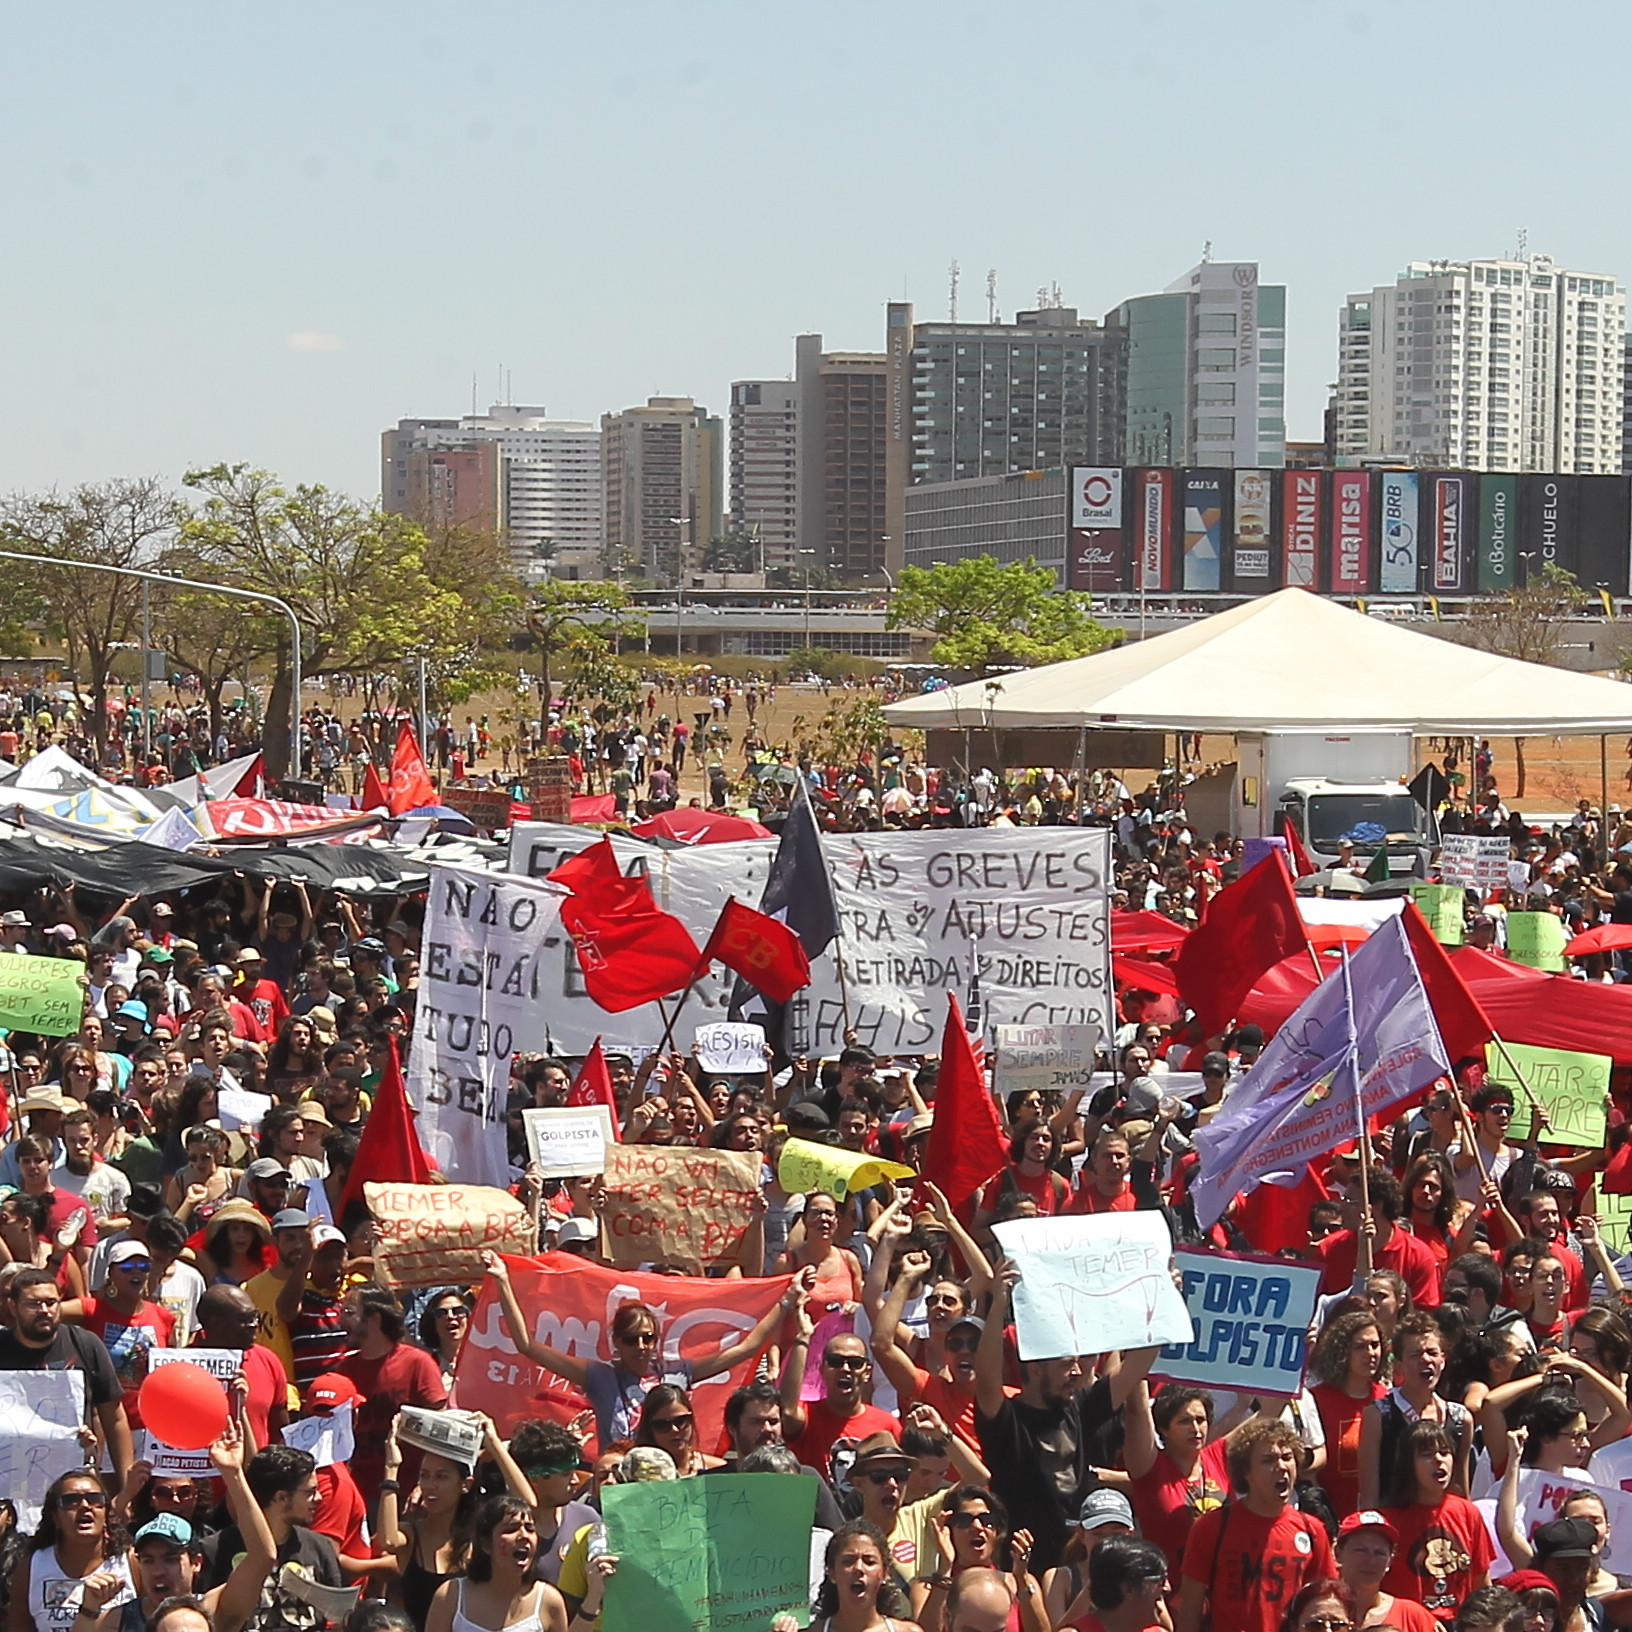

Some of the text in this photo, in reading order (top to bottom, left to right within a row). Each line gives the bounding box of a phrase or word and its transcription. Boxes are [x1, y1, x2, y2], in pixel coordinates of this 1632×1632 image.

[1187, 480, 1219, 490] CAIXA
[1386, 484, 1403, 519] BRB
[1081, 507, 1113, 518] Brasal
[1297, 476, 1316, 551] DINIZ
[1340, 482, 1362, 580] marisa
[1443, 501, 1458, 582] BAHIA
[926, 850, 1102, 894] GREVES
[444, 879, 537, 934] NÃO
[940, 897, 1107, 947] AJUSTES
[426, 940, 531, 998] ESTÁ
[29, 1014, 73, 1030] TEMER
[44, 998, 70, 1012] SEM
[1002, 1027, 1057, 1046] LUTAR
[1002, 1049, 1083, 1070] SEMPRE
[1496, 1050, 1586, 1094] LUTAR
[539, 1129, 602, 1143] GOLPISTA
[613, 1149, 669, 1177] NÃO
[700, 1222, 749, 1255] PM
[1068, 1247, 1168, 1279] TEMER
[1181, 1270, 1291, 1319] FORA
[650, 1488, 753, 1532] BASTA
